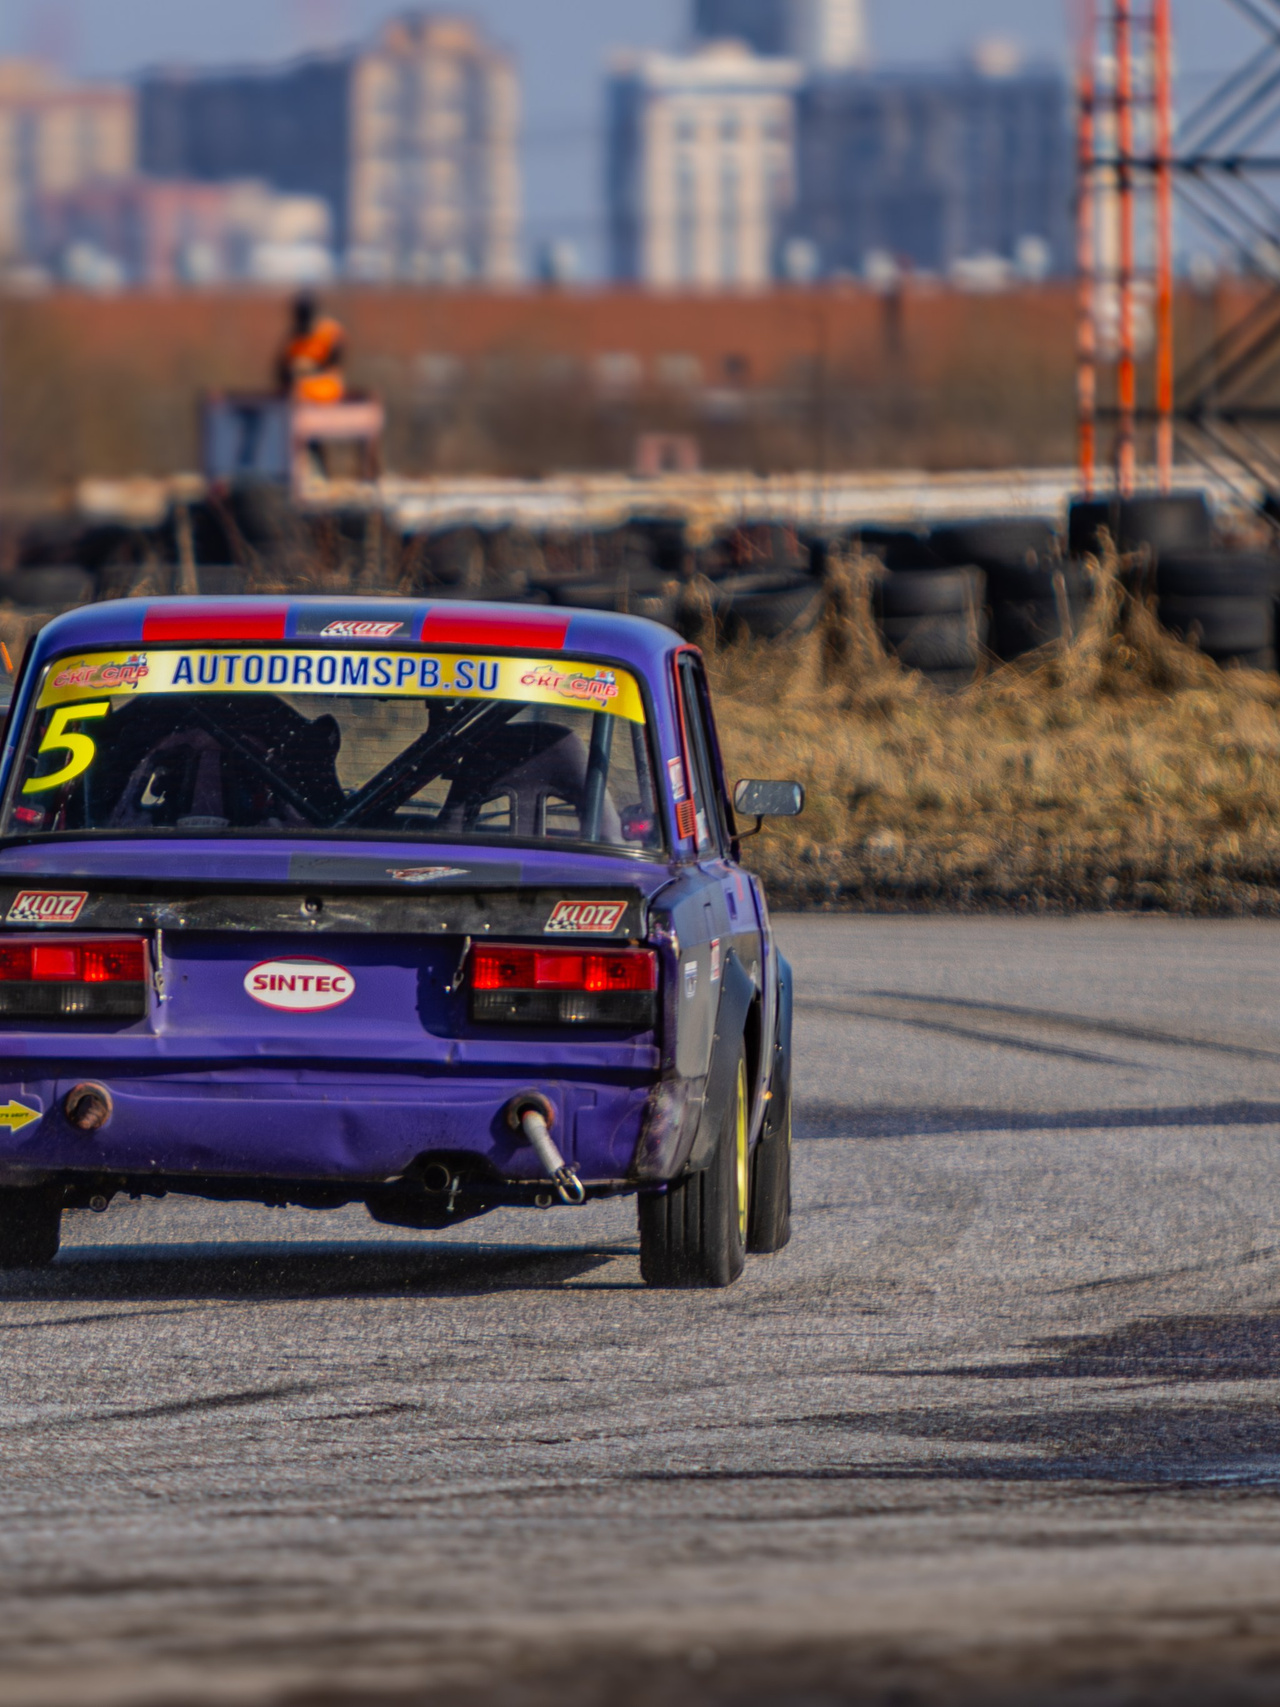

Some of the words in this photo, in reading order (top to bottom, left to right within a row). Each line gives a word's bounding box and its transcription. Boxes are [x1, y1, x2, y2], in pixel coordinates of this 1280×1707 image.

[330, 622, 396, 632] KLOTZ
[53, 667, 98, 687] СКГ
[101, 665, 149, 682] СПБ
[171, 655, 499, 691] AUTODROMSPB.SU
[520, 673, 565, 688] СКГ
[570, 677, 618, 697] СПБ
[22, 701, 110, 794] 5
[17, 895, 82, 914] KLOTZ
[555, 905, 621, 925] KLOTZ
[253, 974, 346, 992] SINTEC
